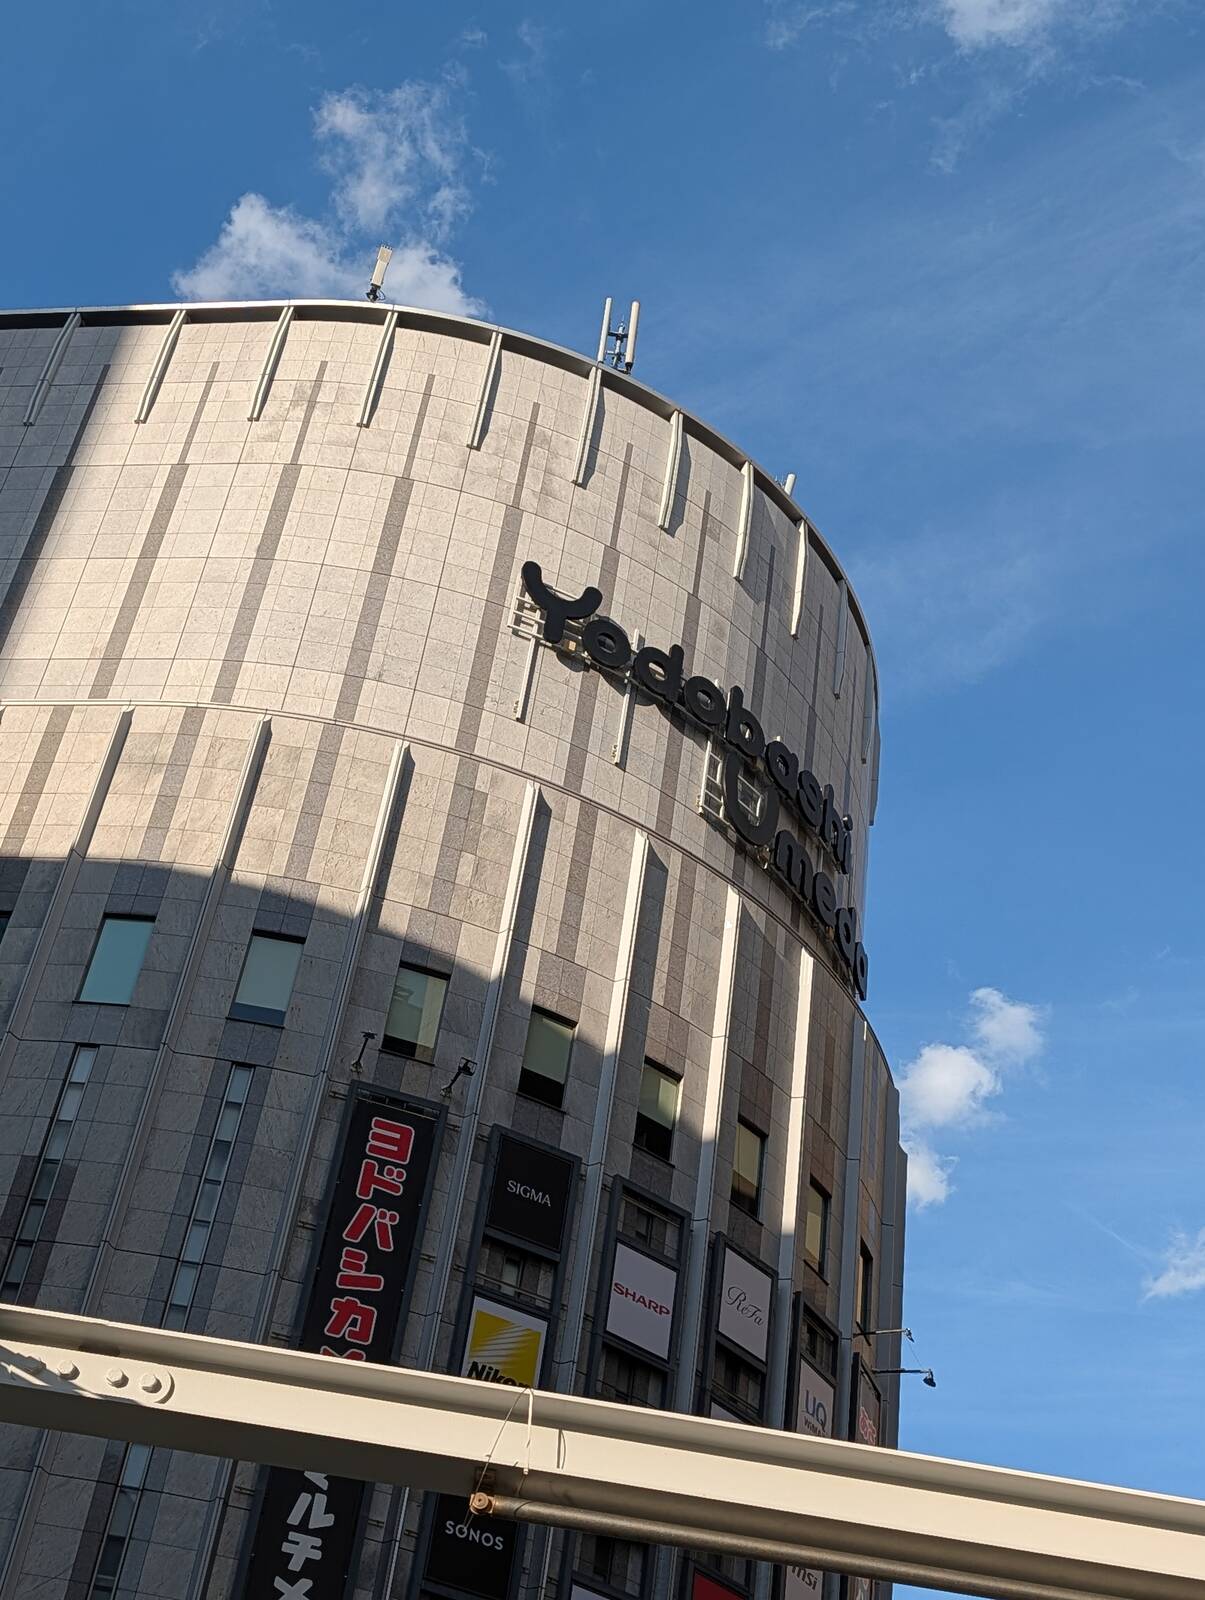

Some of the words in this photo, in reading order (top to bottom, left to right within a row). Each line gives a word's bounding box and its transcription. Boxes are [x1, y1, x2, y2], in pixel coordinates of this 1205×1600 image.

[521, 561, 853, 875] Yodobashi
[723, 752, 868, 1001] Umeda
[506, 1179, 552, 1207] SIGMA
[612, 1282, 671, 1317] SHARP
[725, 1286, 764, 1326] ReFa
[467, 1361, 530, 1388] Niko
[805, 1389, 827, 1433] UQ
[445, 1520, 504, 1550] SONOS
